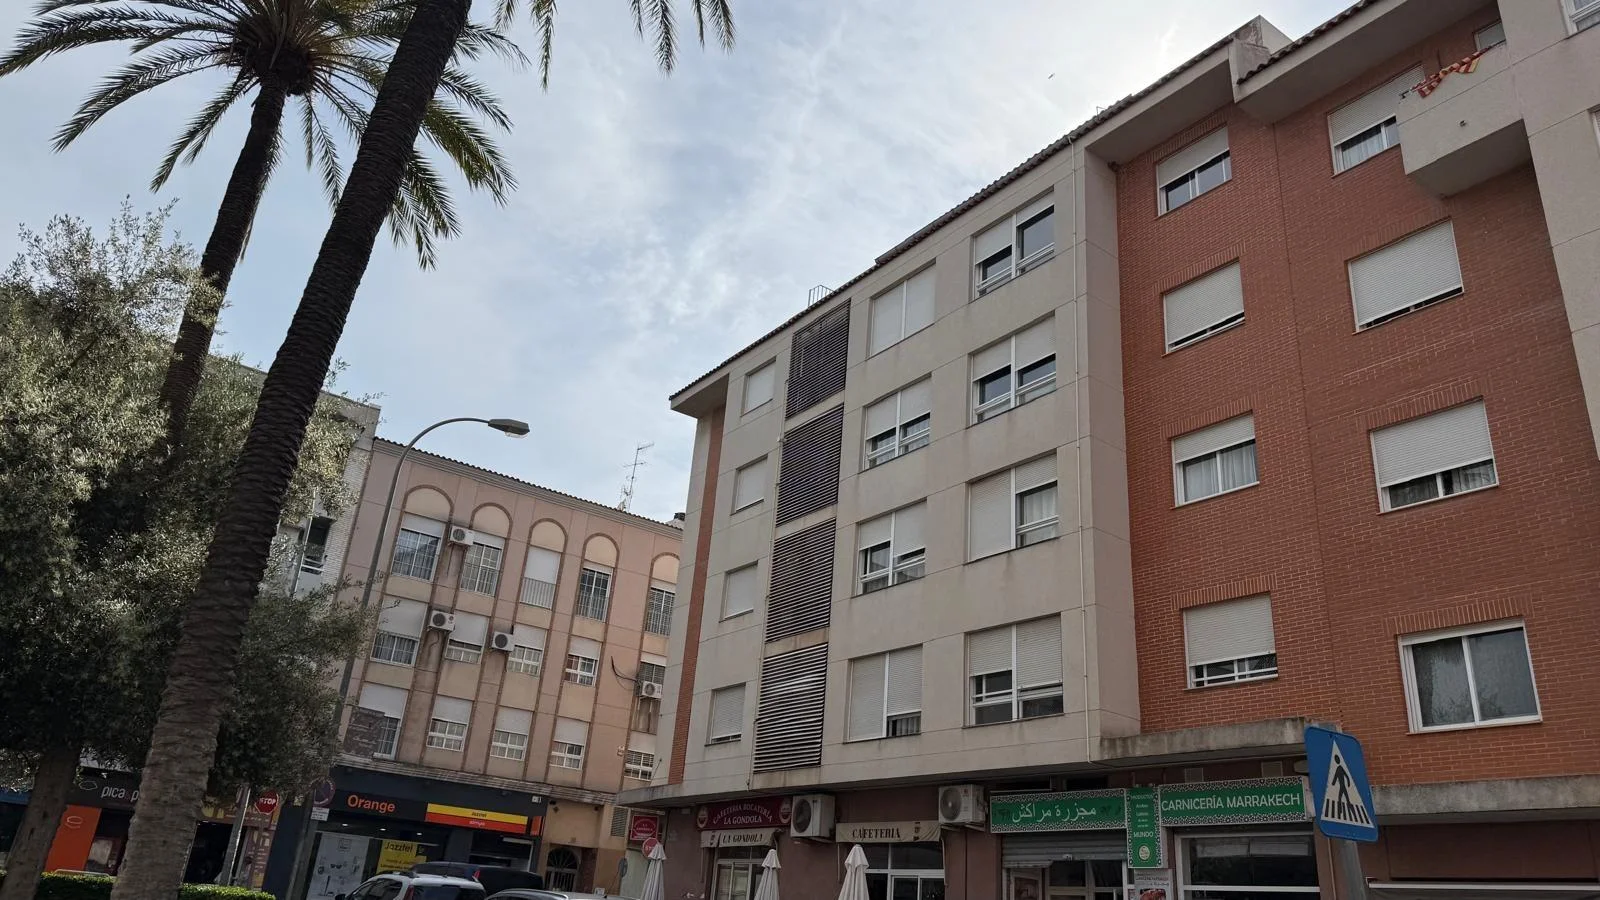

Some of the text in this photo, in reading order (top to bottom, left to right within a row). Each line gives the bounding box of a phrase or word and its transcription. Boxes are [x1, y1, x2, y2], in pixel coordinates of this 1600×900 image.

[258, 797, 277, 806] STOP
[347, 794, 396, 814] Orange
[1161, 793, 1300, 811] CARNICERÍA MARRAKECH
[1012, 802, 1097, 823] مجزرة مراكش
[732, 815, 762, 824] GONDOLA
[723, 834, 763, 843] LA GONDOLA
[852, 827, 901, 840] CAFETERIA
[1133, 830, 1154, 838] MUNDO
[384, 842, 413, 853] Jazztel
